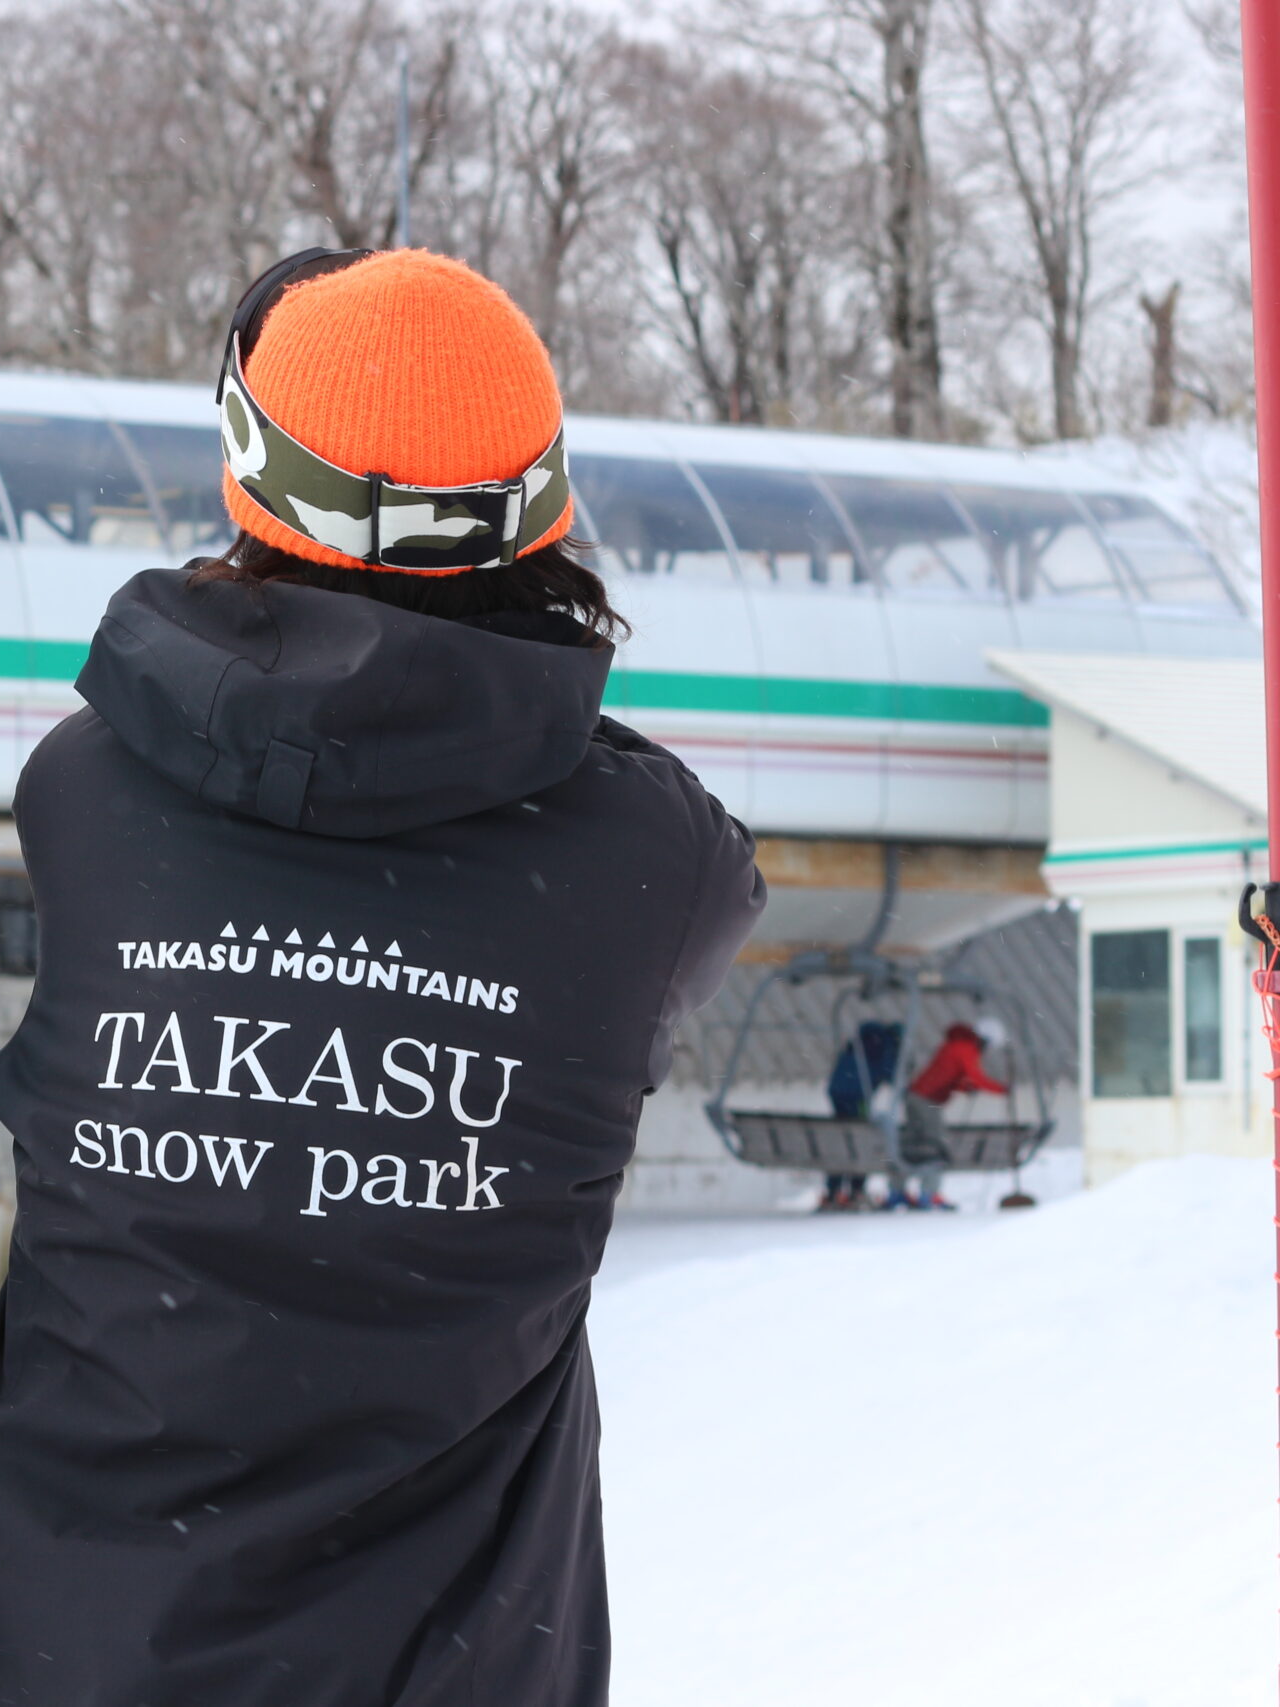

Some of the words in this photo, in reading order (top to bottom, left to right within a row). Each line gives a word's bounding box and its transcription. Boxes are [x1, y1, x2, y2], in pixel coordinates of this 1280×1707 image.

[117, 941, 258, 974] TAKASU
[270, 949, 520, 1014] MOUNTAINS
[93, 1010, 523, 1128] TAKASU
[69, 1119, 275, 1191] snow
[299, 1136, 510, 1217] park
